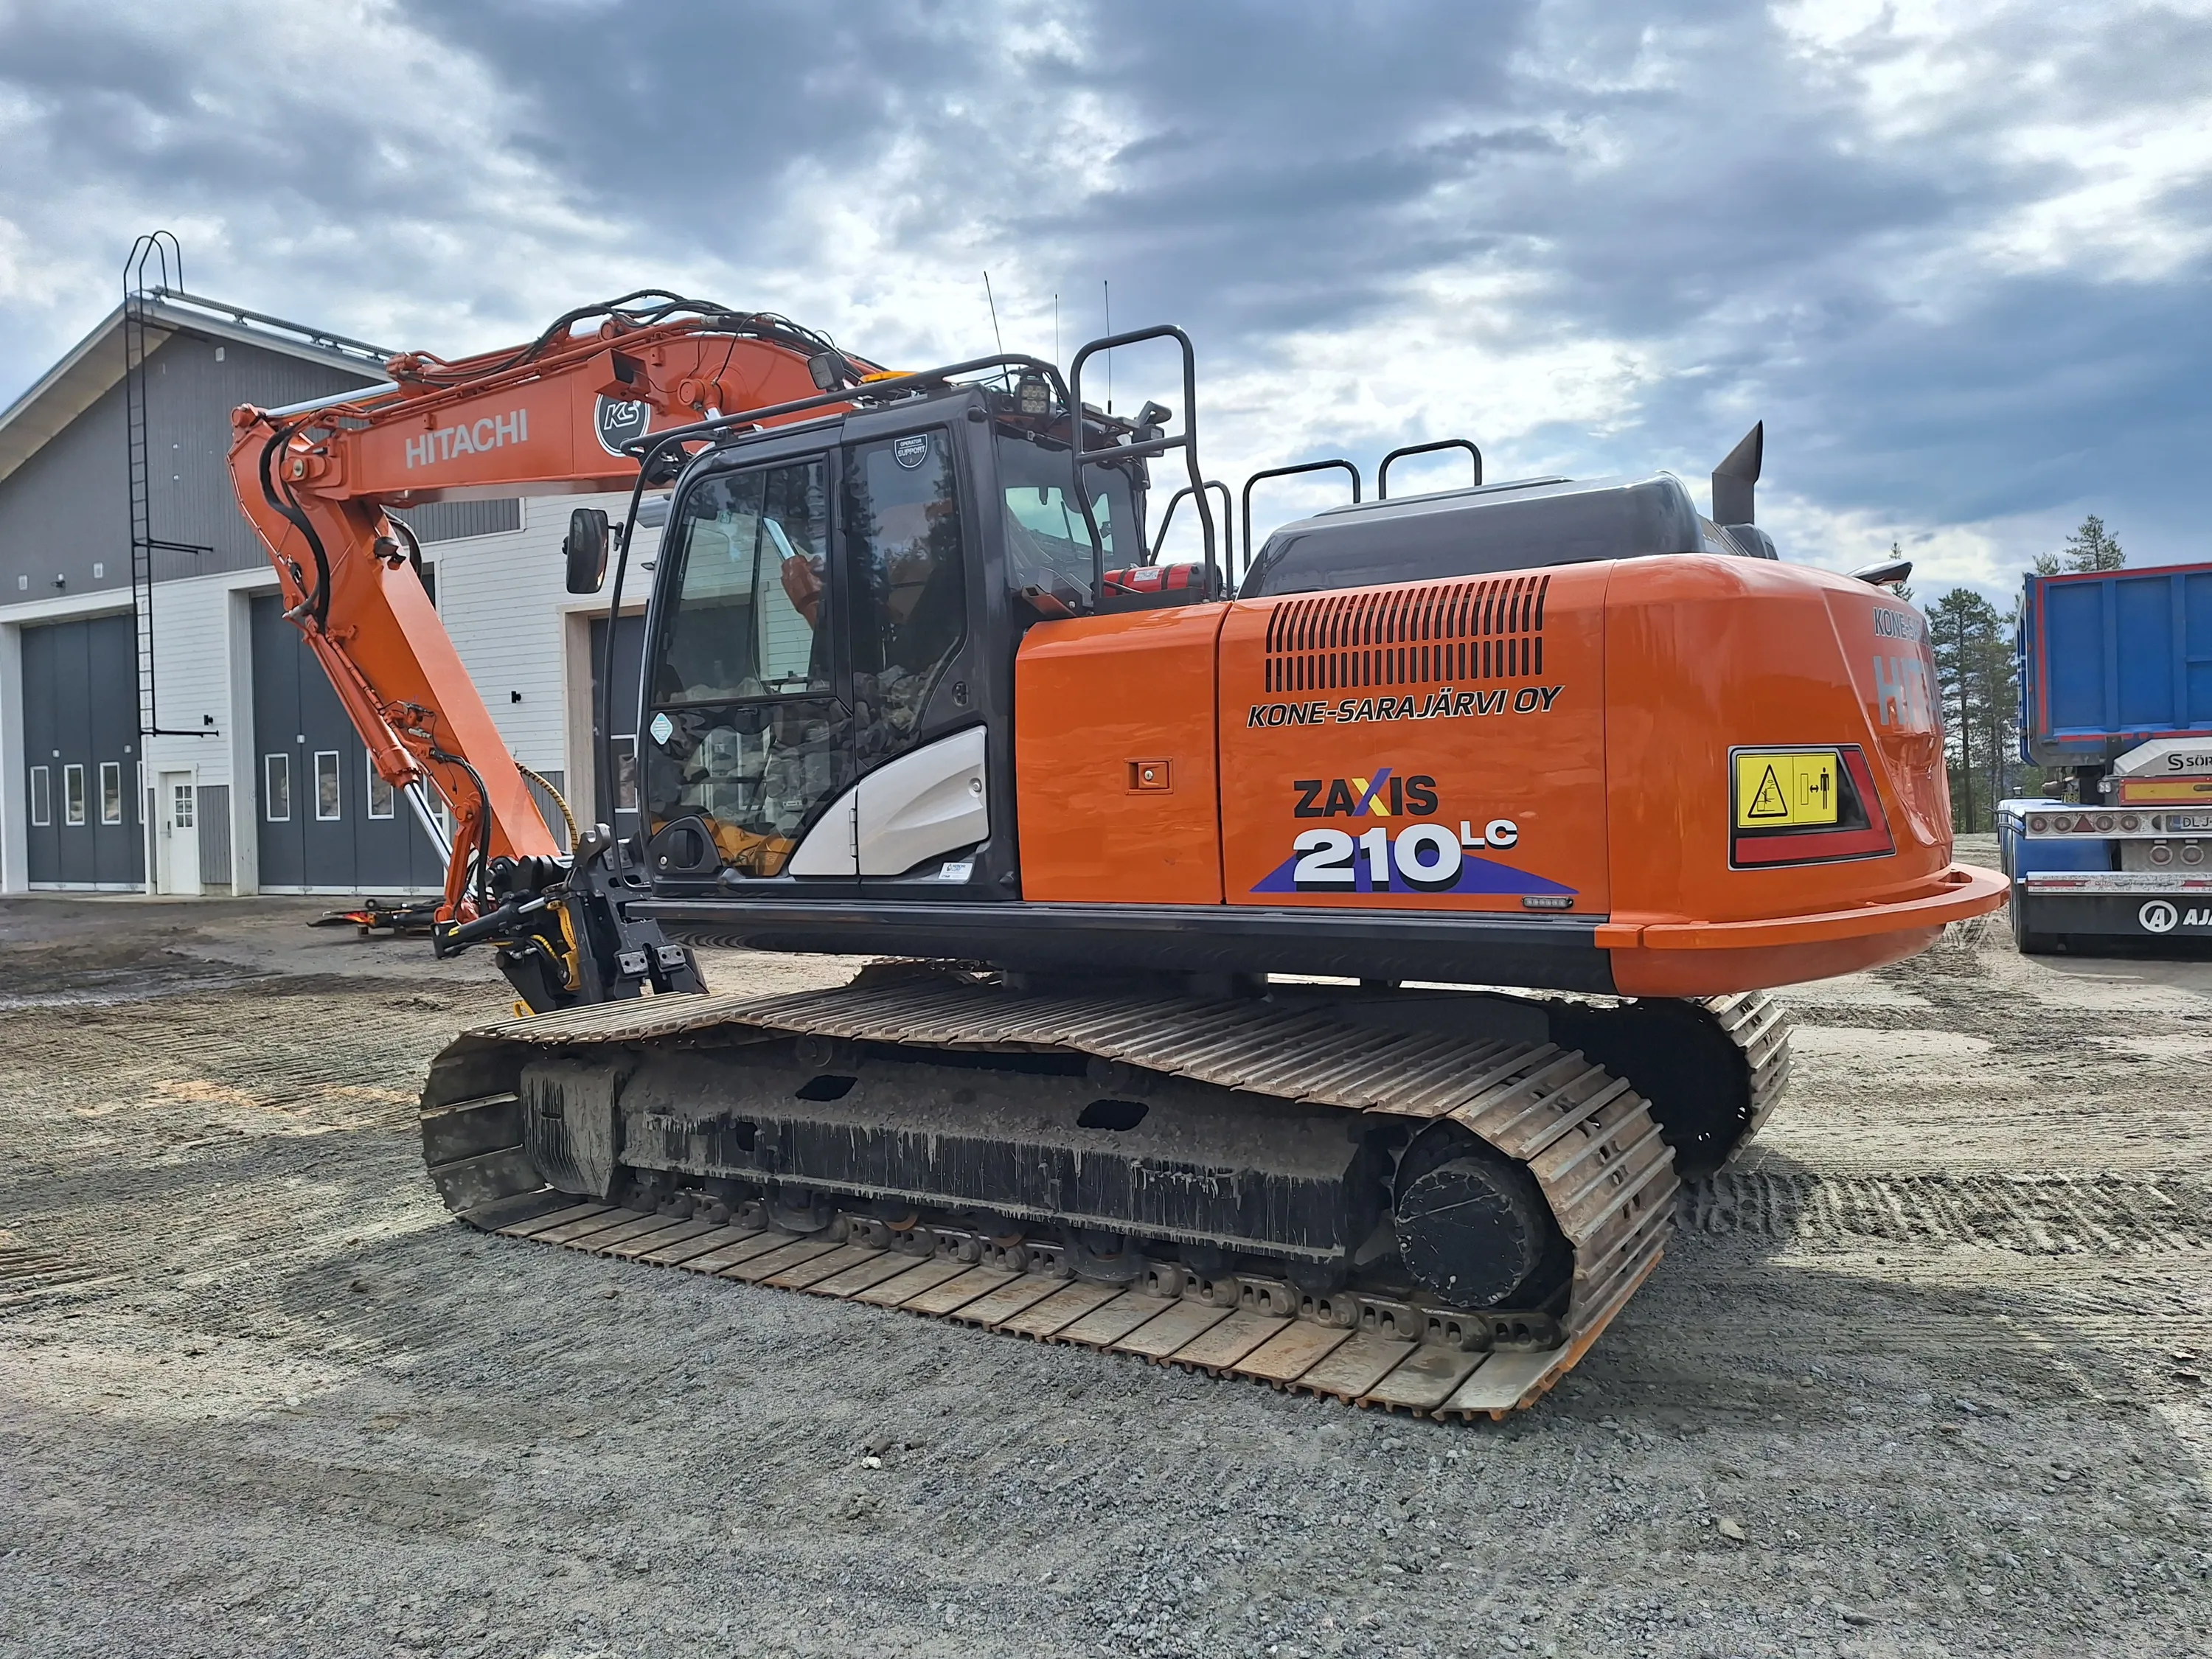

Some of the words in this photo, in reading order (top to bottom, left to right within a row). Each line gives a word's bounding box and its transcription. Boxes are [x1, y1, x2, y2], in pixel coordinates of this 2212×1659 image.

[603, 401, 639, 430] KS
[406, 408, 528, 469] HITACHI
[897, 445, 925, 457] SUPPORT
[900, 438, 922, 447] OPERATOR
[1247, 686, 1509, 728] KONE-SARAJÄRVI
[1512, 684, 1565, 714] OY
[1293, 768, 1439, 818] ZAXIS
[1293, 823, 1463, 892] 210
